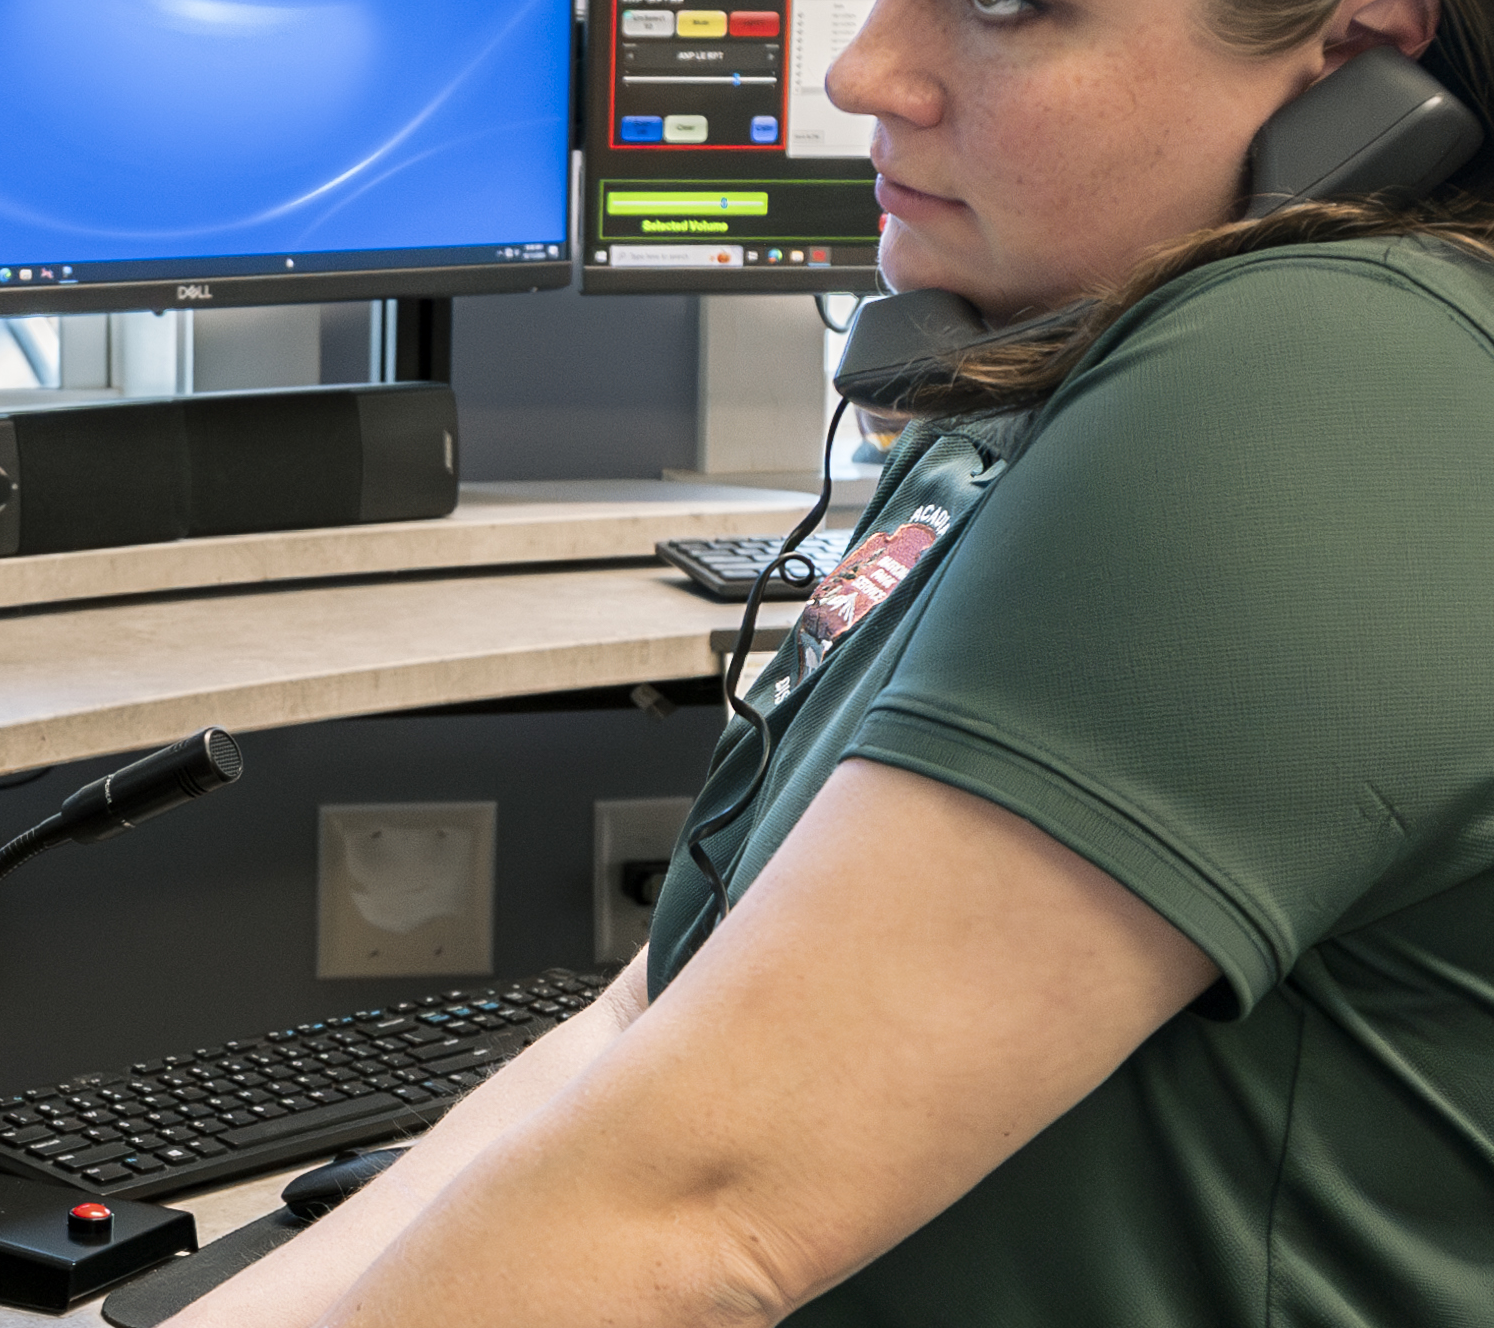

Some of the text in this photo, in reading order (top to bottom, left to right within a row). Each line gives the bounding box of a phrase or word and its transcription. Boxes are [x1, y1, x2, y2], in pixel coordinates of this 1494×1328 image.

[642, 219, 729, 232] Selected Volume
[176, 283, 213, 300] DELL
[909, 504, 951, 536] ACADIA
[870, 568, 898, 588] PARK
